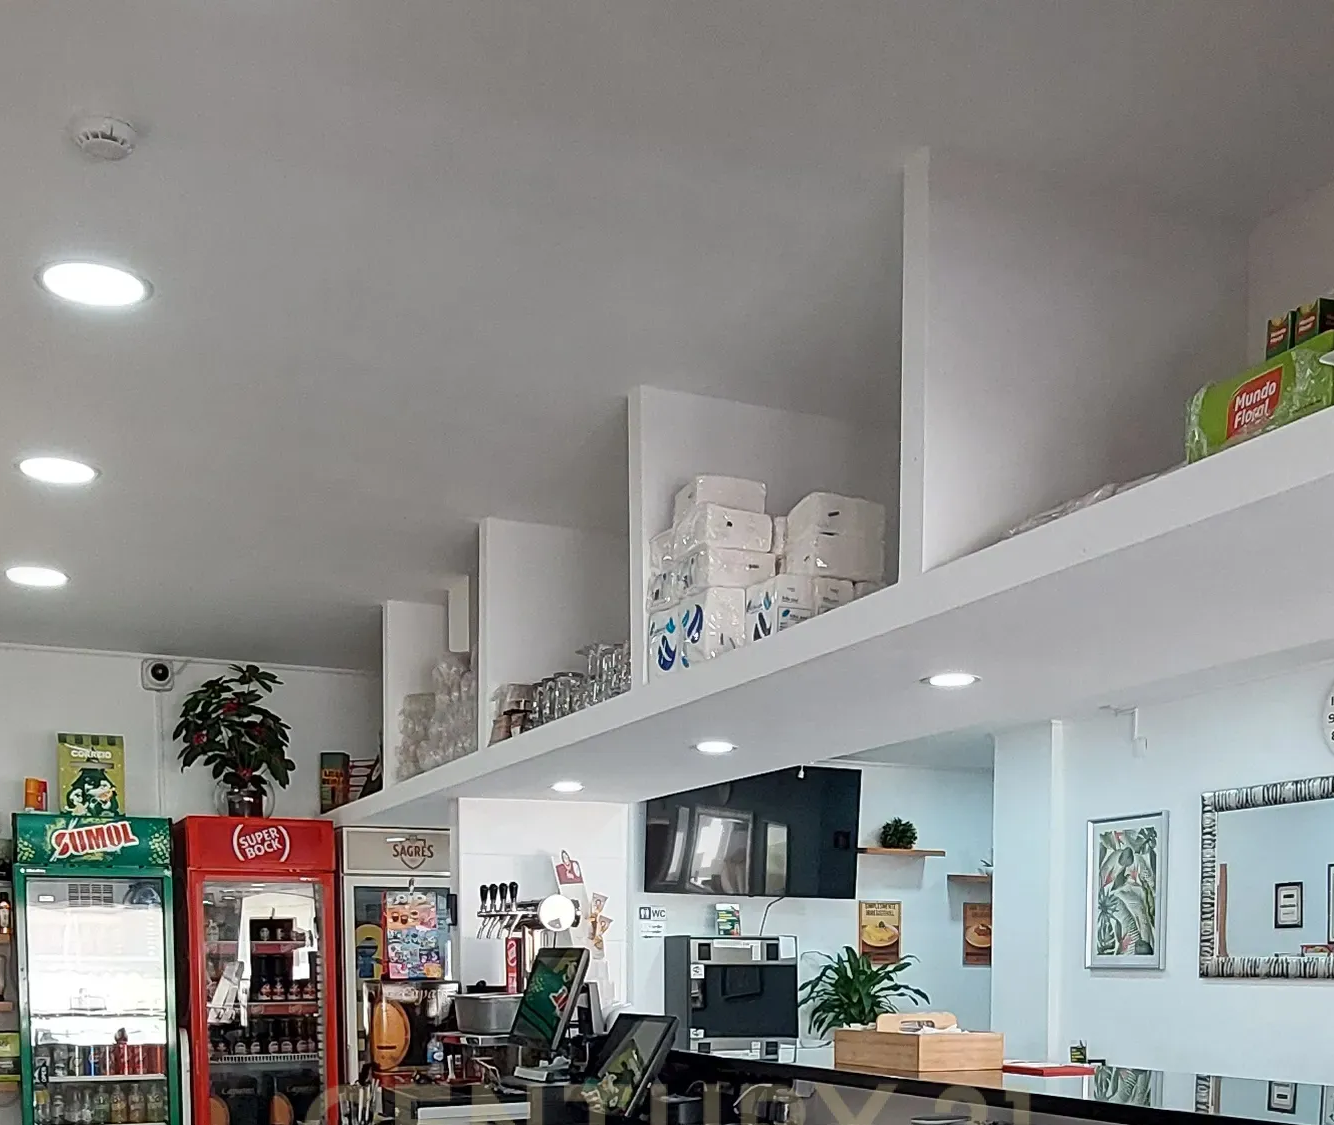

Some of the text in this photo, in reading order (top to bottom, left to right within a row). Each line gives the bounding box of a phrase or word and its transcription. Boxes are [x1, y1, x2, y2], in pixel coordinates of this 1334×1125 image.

[1234, 379, 1277, 412] Mundo
[1234, 401, 1271, 429] Floral
[53, 821, 139, 858] SUMOL
[238, 827, 280, 849] SUPER
[244, 838, 283, 860] BOCK
[392, 843, 434, 858] SAGRES
[651, 908, 667, 918] WC
